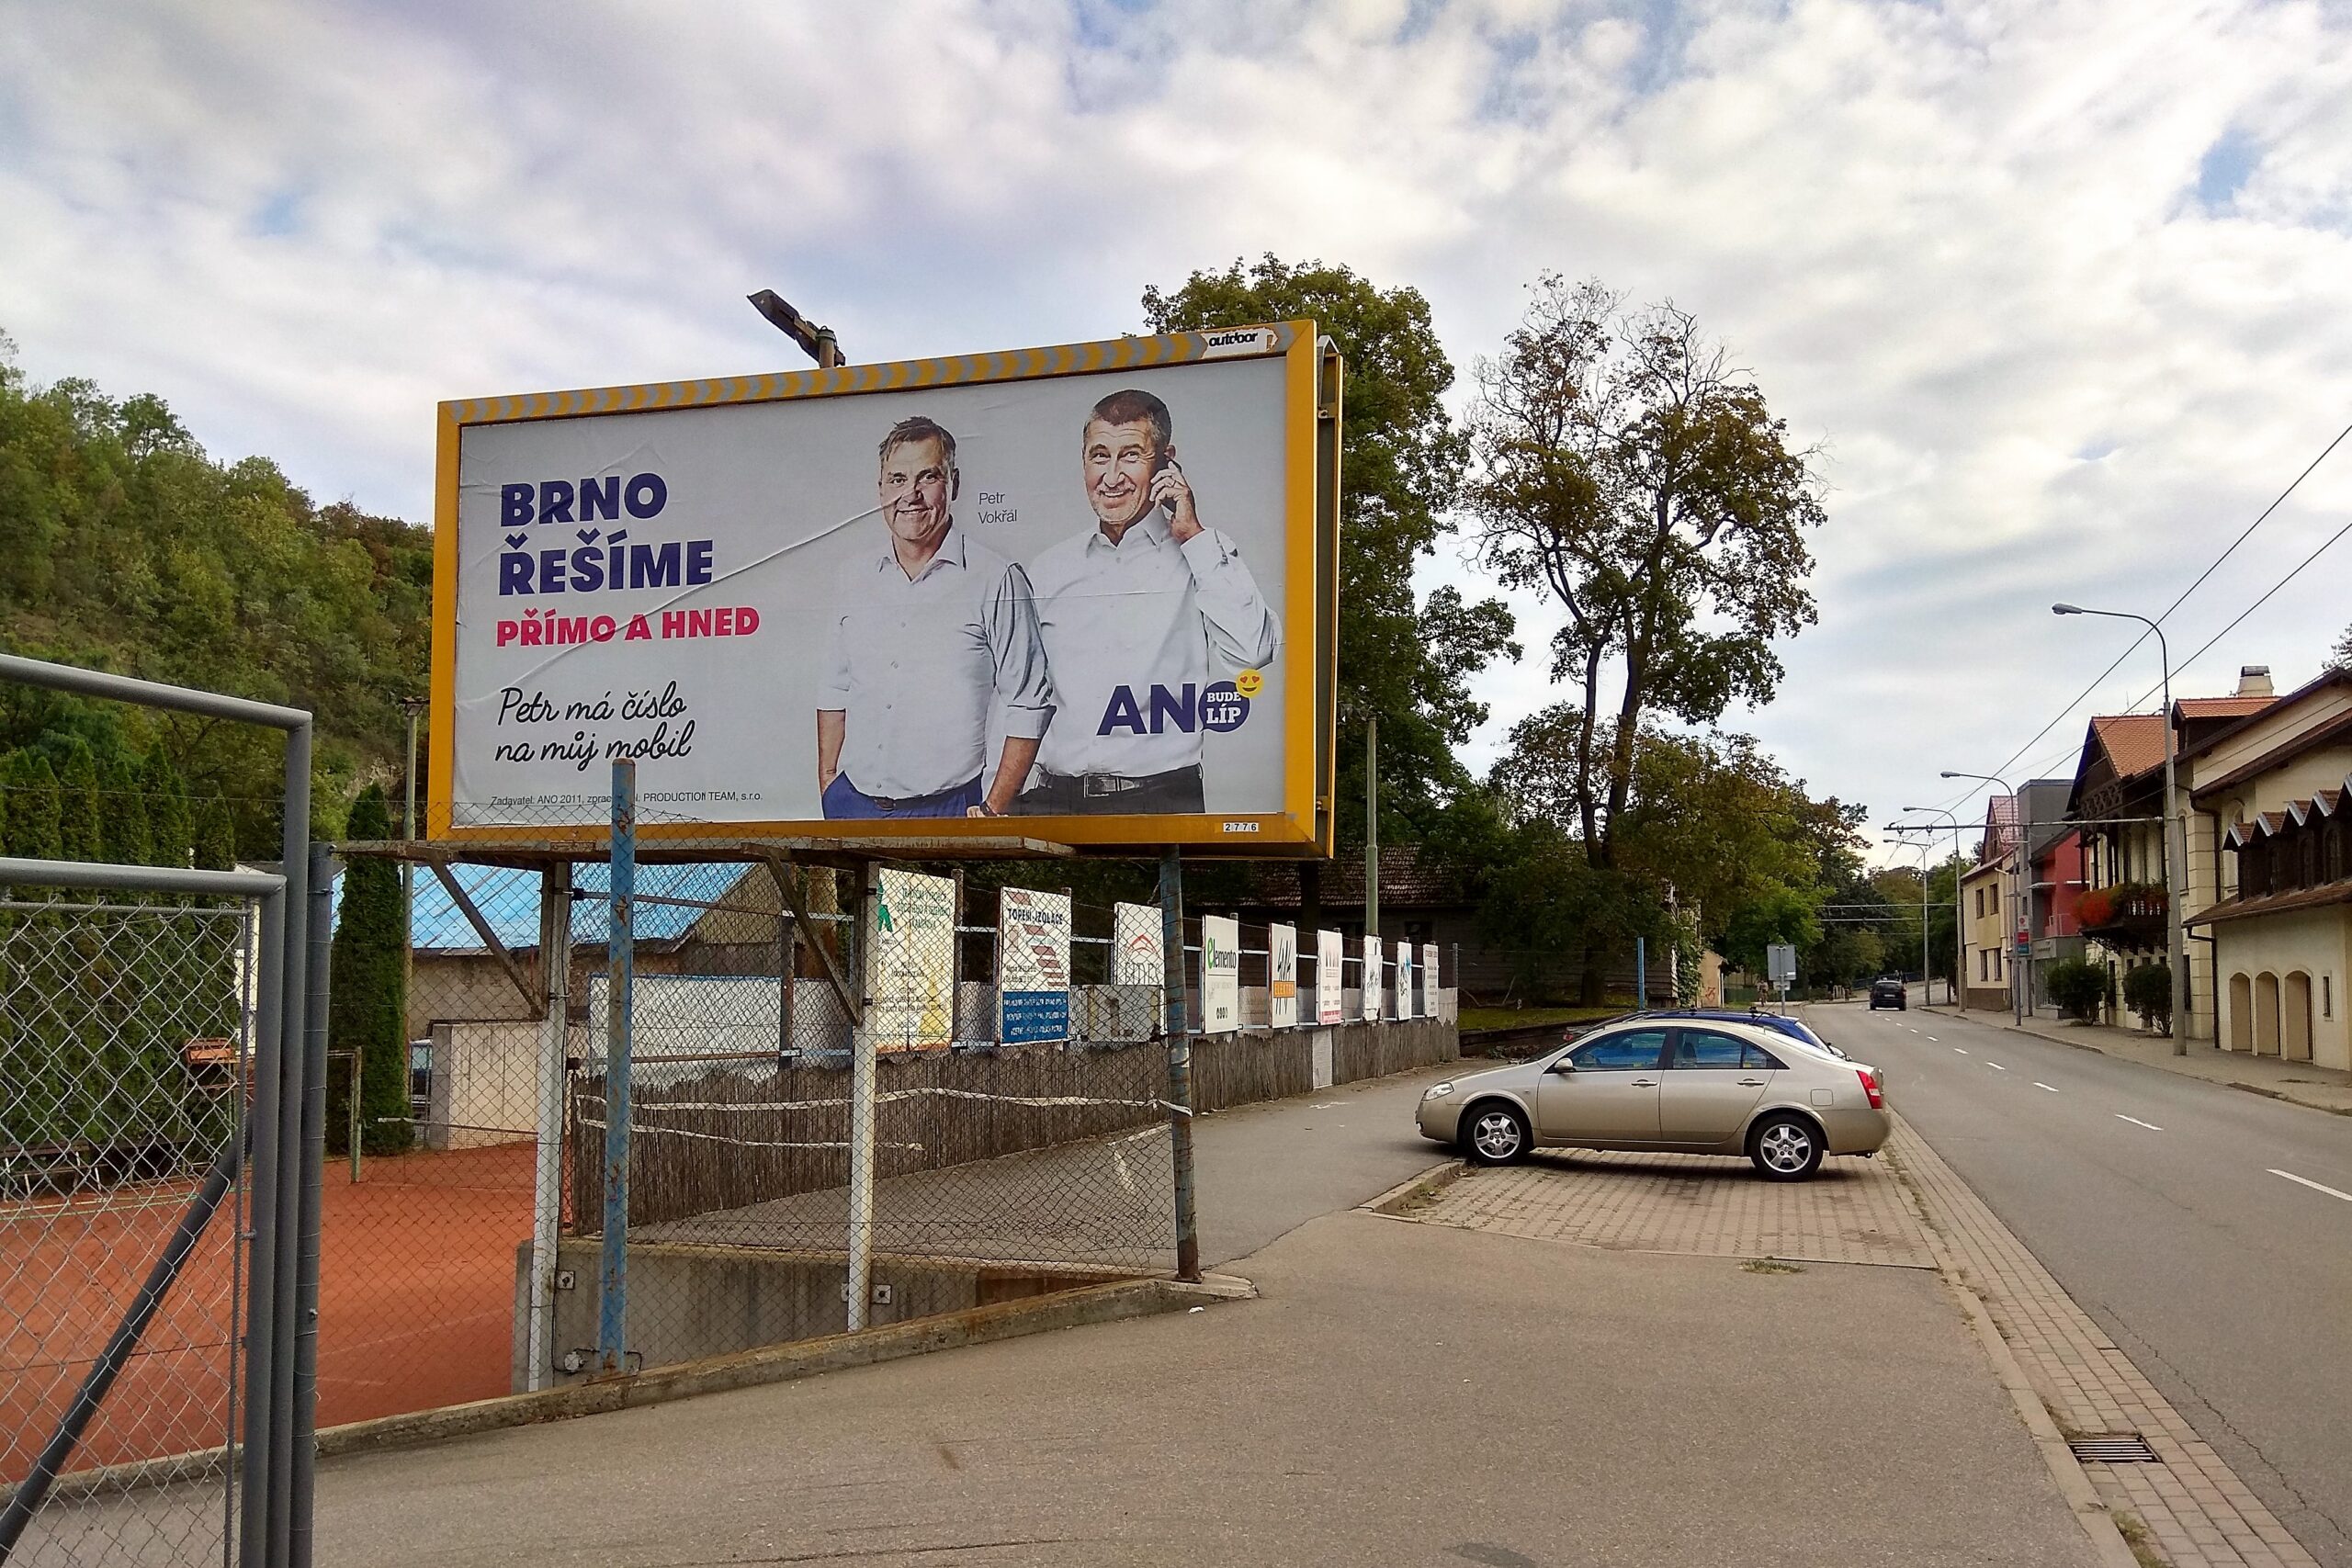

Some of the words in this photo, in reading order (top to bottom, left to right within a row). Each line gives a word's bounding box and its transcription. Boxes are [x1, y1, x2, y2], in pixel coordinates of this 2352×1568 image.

[1209, 333, 1258, 346] outdoor
[501, 472, 668, 527] BRNO
[978, 491, 1006, 505] Petr
[978, 509, 1017, 524] Vokřál
[499, 528, 713, 595] ŘEŠÍME
[496, 607, 616, 647] PŘÍMO
[625, 614, 651, 640] A
[662, 606, 760, 639] HNED
[498, 687, 560, 726] Petr
[565, 691, 615, 720] má
[622, 680, 687, 720] číslo
[1206, 692, 1241, 703] BUDE
[1206, 703, 1241, 724] LÍP
[495, 741, 535, 762] na
[540, 730, 599, 772] můj
[605, 719, 695, 761] mobil
[537, 795, 559, 805] ANO
[560, 794, 584, 806] 2011,
[643, 791, 707, 803] PRODUCTION
[708, 791, 739, 803] TEAM,
[741, 793, 763, 802] s.r.o.
[1225, 822, 1258, 832] 2776
[1207, 937, 1237, 969] elemento
